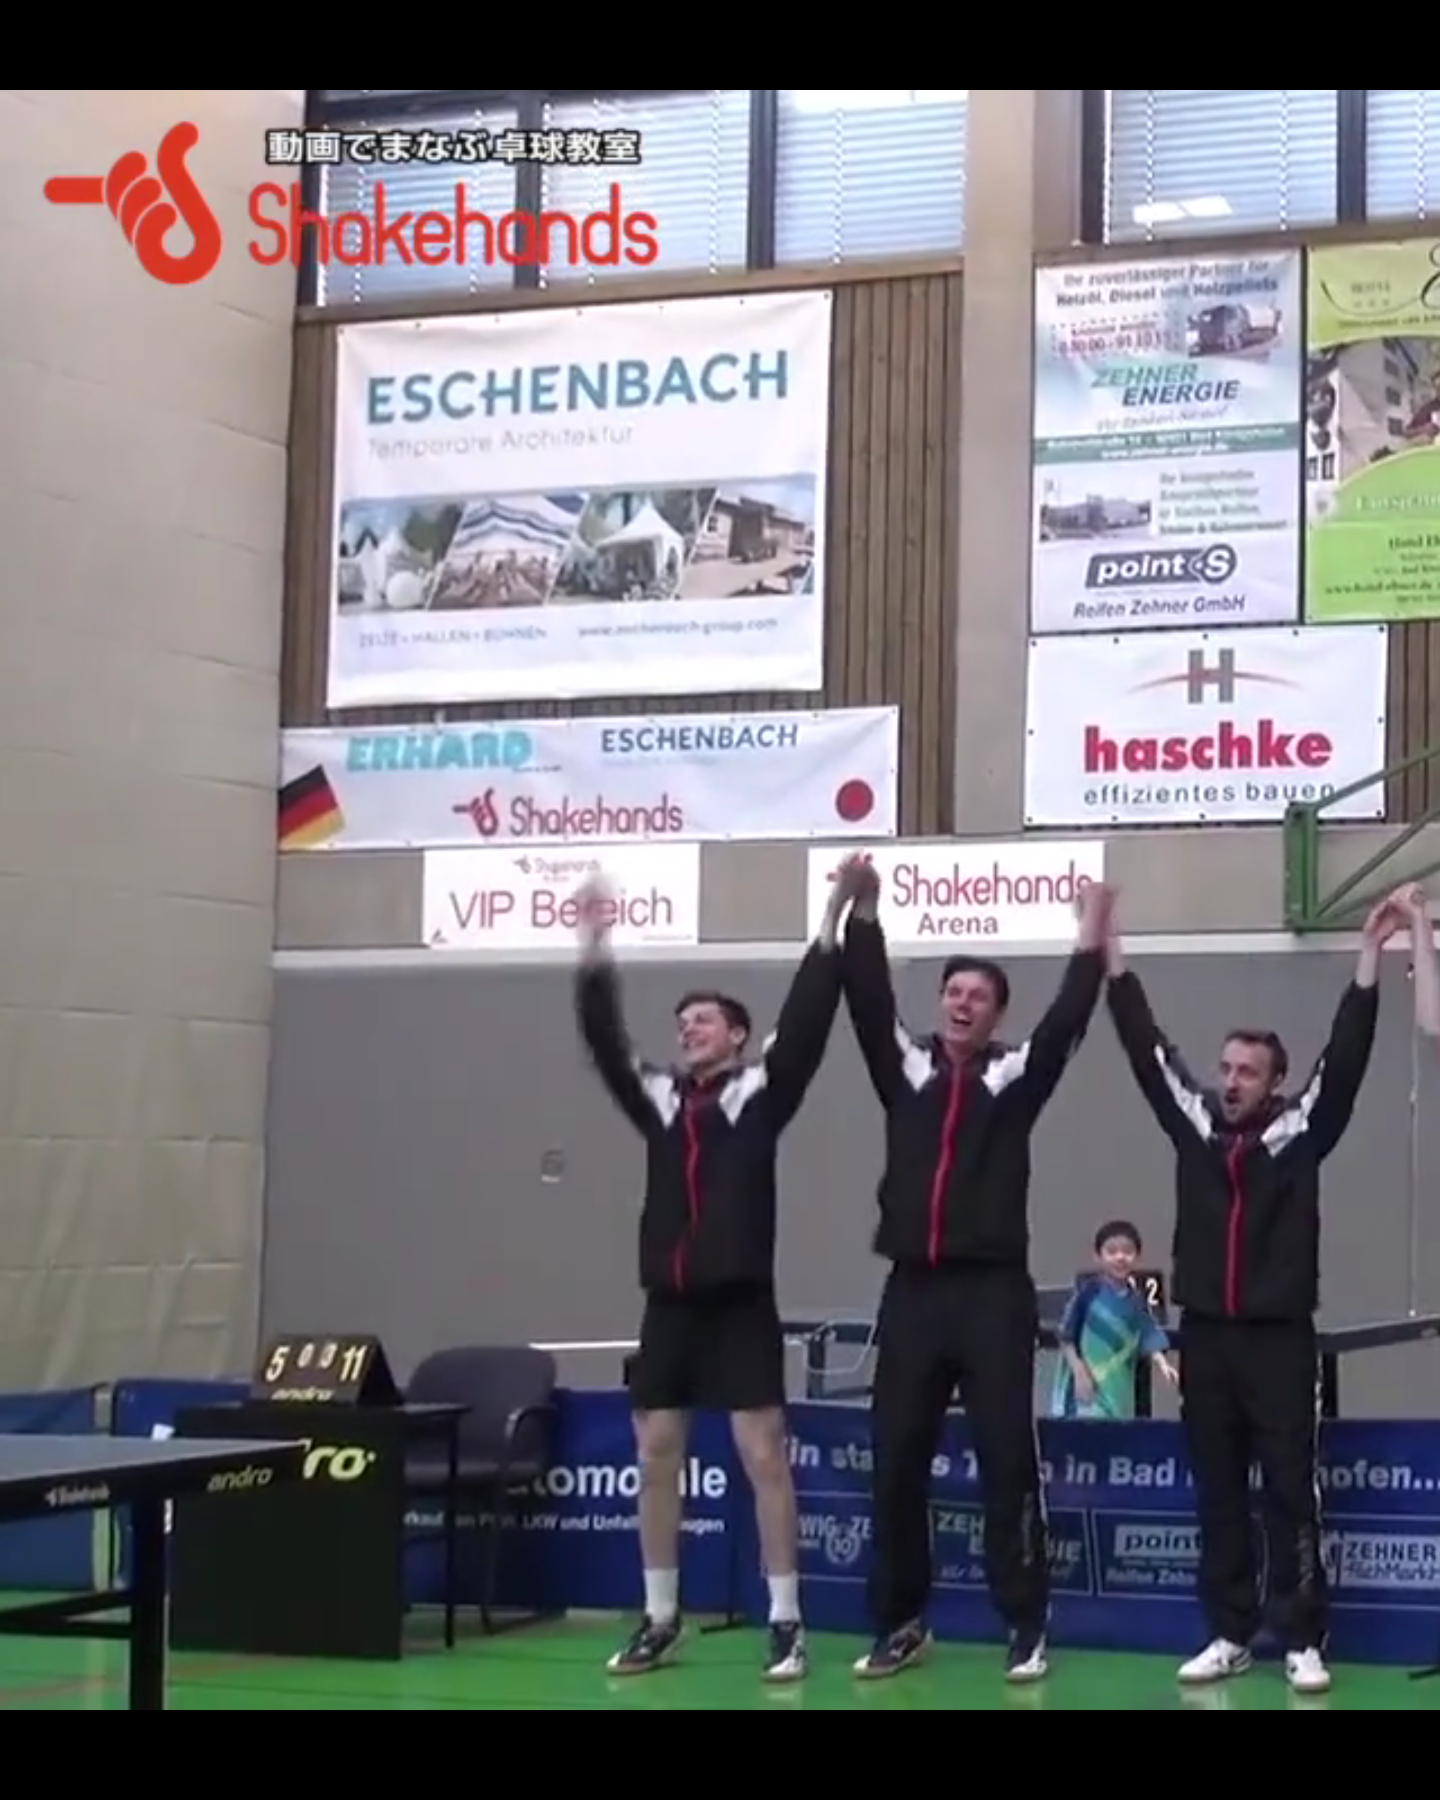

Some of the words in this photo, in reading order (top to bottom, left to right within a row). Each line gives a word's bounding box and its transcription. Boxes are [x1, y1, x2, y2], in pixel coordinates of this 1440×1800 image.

[1189, 262, 1243, 278] Partner
[1110, 288, 1155, 304] Diesel
[367, 350, 788, 425] ESCHENBACH
[1091, 364, 1199, 388] ZEHNER
[1122, 380, 1240, 407] ENERGIE
[501, 426, 634, 454] Architektur
[1097, 554, 1186, 585] point
[1204, 547, 1231, 578] S
[1073, 601, 1125, 618] Reifen
[1130, 599, 1188, 616] Zehner
[1193, 595, 1246, 612] GmbH
[346, 731, 533, 772] ERHARD
[601, 724, 798, 753] ESCHENBACH
[1084, 719, 1333, 773] haschke
[1084, 784, 1236, 806] effizientes
[1246, 781, 1335, 802] bauen
[510, 792, 684, 837] Shakehands
[449, 890, 515, 930] VIP
[531, 886, 673, 930] Beeich
[917, 912, 998, 936] Arena
[1145, 1277, 1160, 1307] 2
[266, 1345, 291, 1382] 5
[340, 1344, 368, 1382] 11
[785, 1436, 820, 1467] in
[1065, 1453, 1097, 1485] in
[1109, 1456, 1176, 1487] Bad
[208, 1464, 274, 1493] andro
[561, 1513, 590, 1531] und
[1346, 1541, 1438, 1563] ZEHNER
